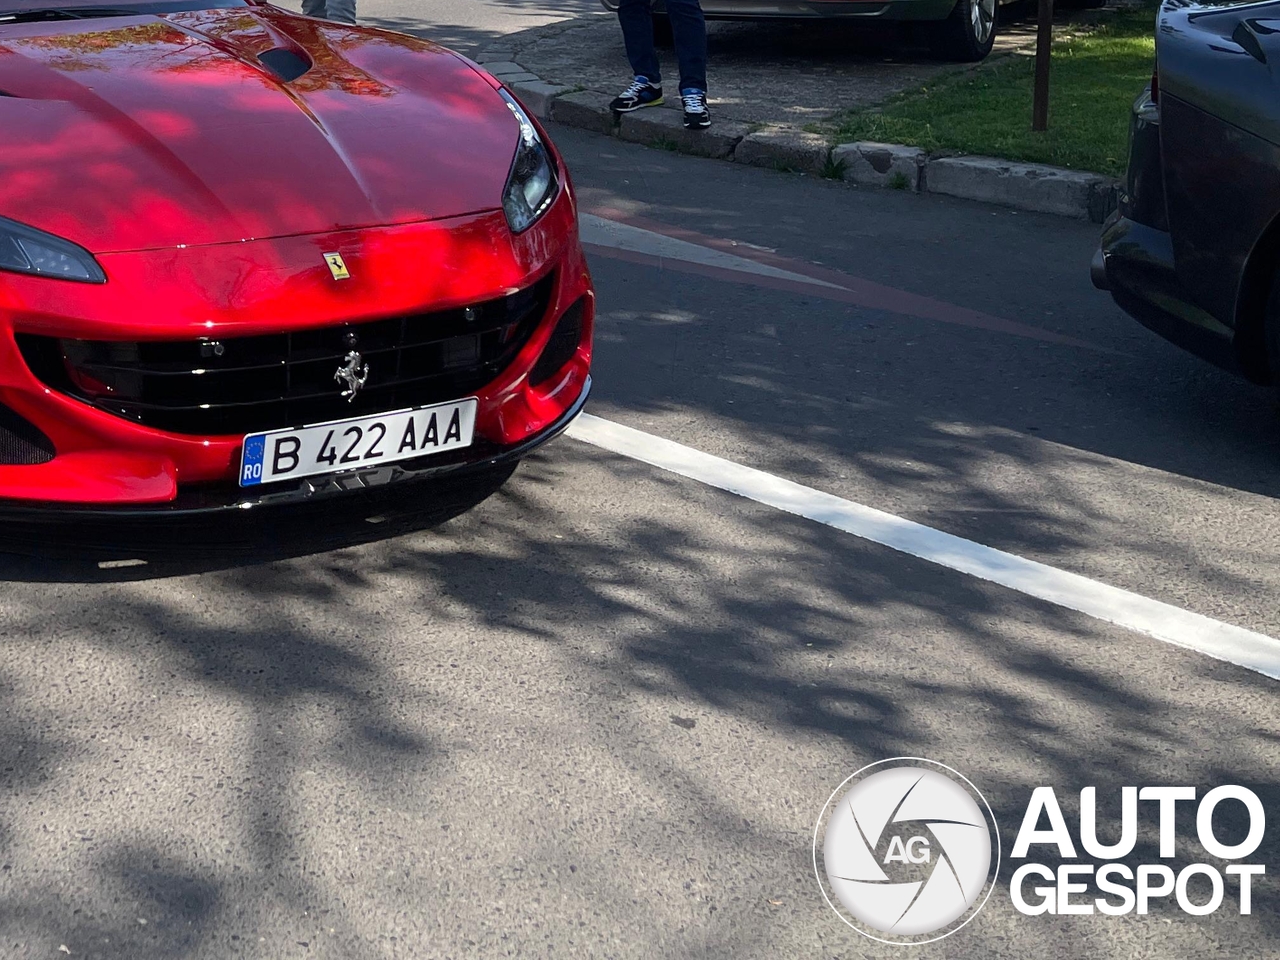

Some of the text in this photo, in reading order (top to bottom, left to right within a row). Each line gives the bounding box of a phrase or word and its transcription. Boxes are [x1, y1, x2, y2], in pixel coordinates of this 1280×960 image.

[271, 407, 462, 475] B 422 AAA
[243, 462, 262, 480] RO
